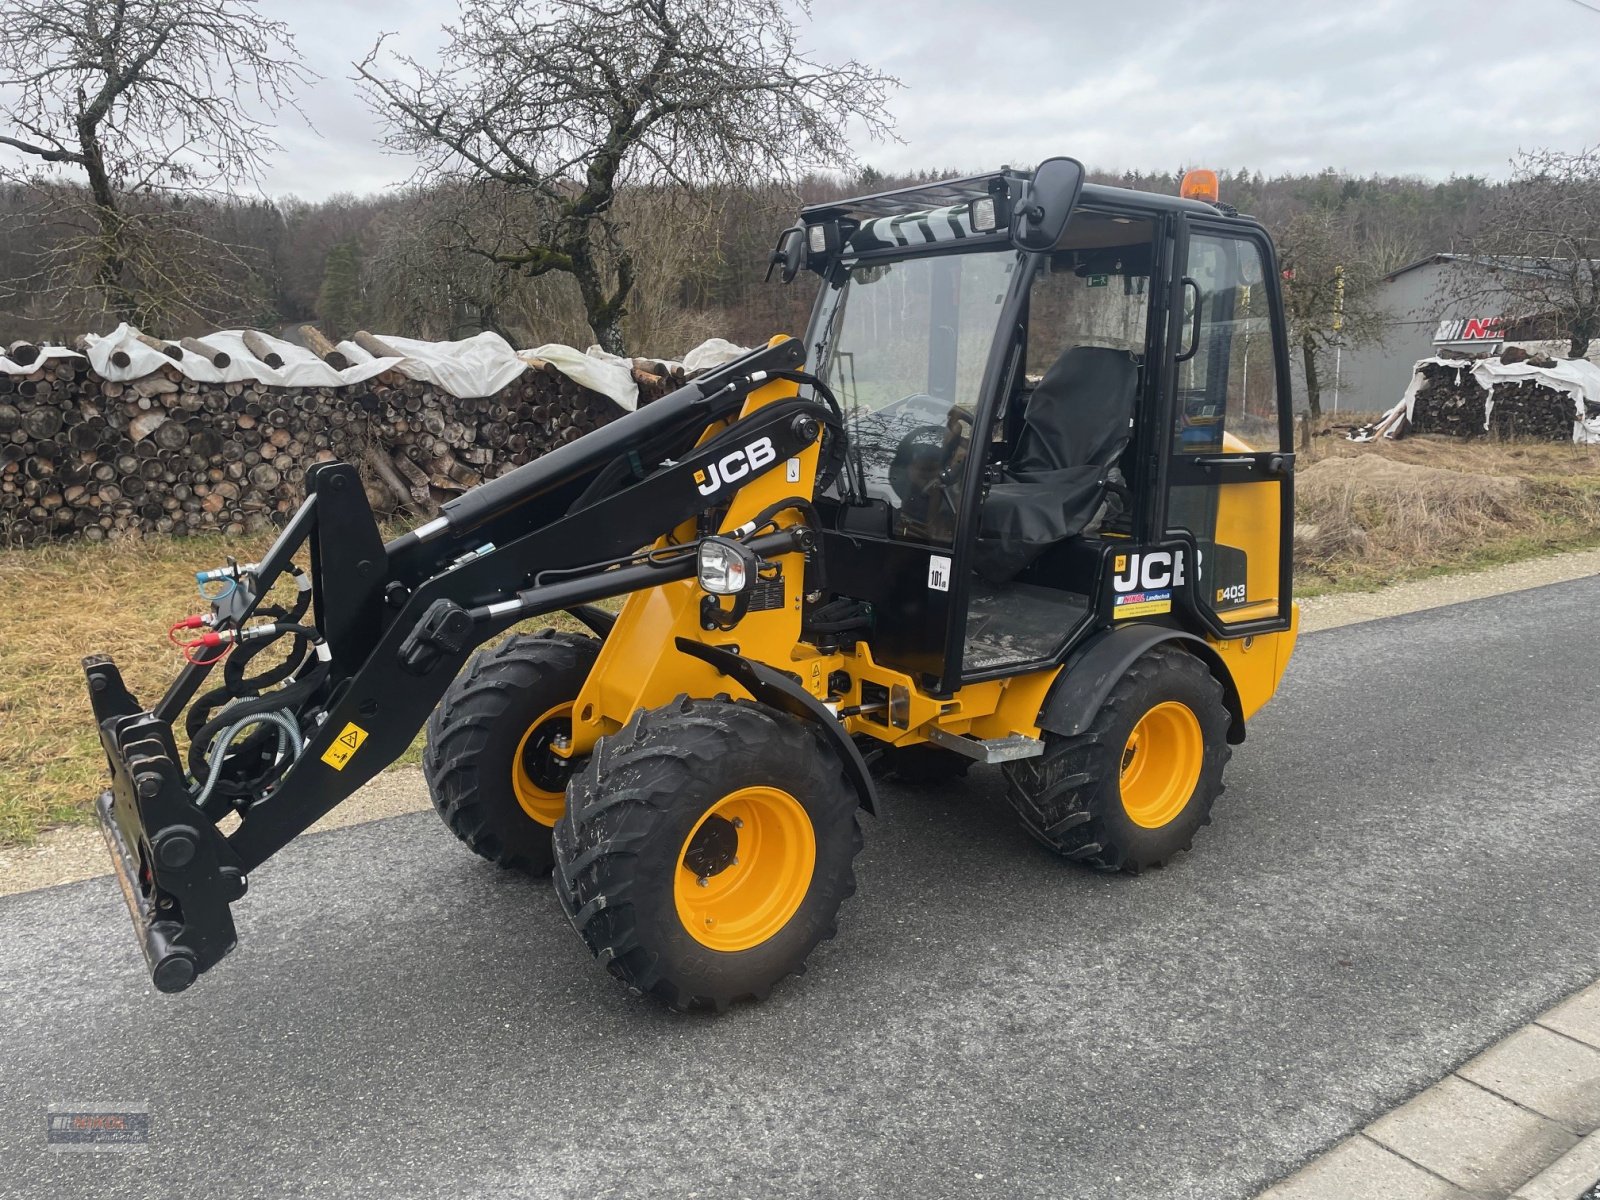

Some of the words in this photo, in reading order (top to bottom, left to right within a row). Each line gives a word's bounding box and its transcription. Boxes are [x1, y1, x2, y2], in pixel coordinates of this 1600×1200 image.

[693, 436, 776, 496] JCB
[931, 570, 942, 587] 101
[1223, 584, 1246, 600] 403
